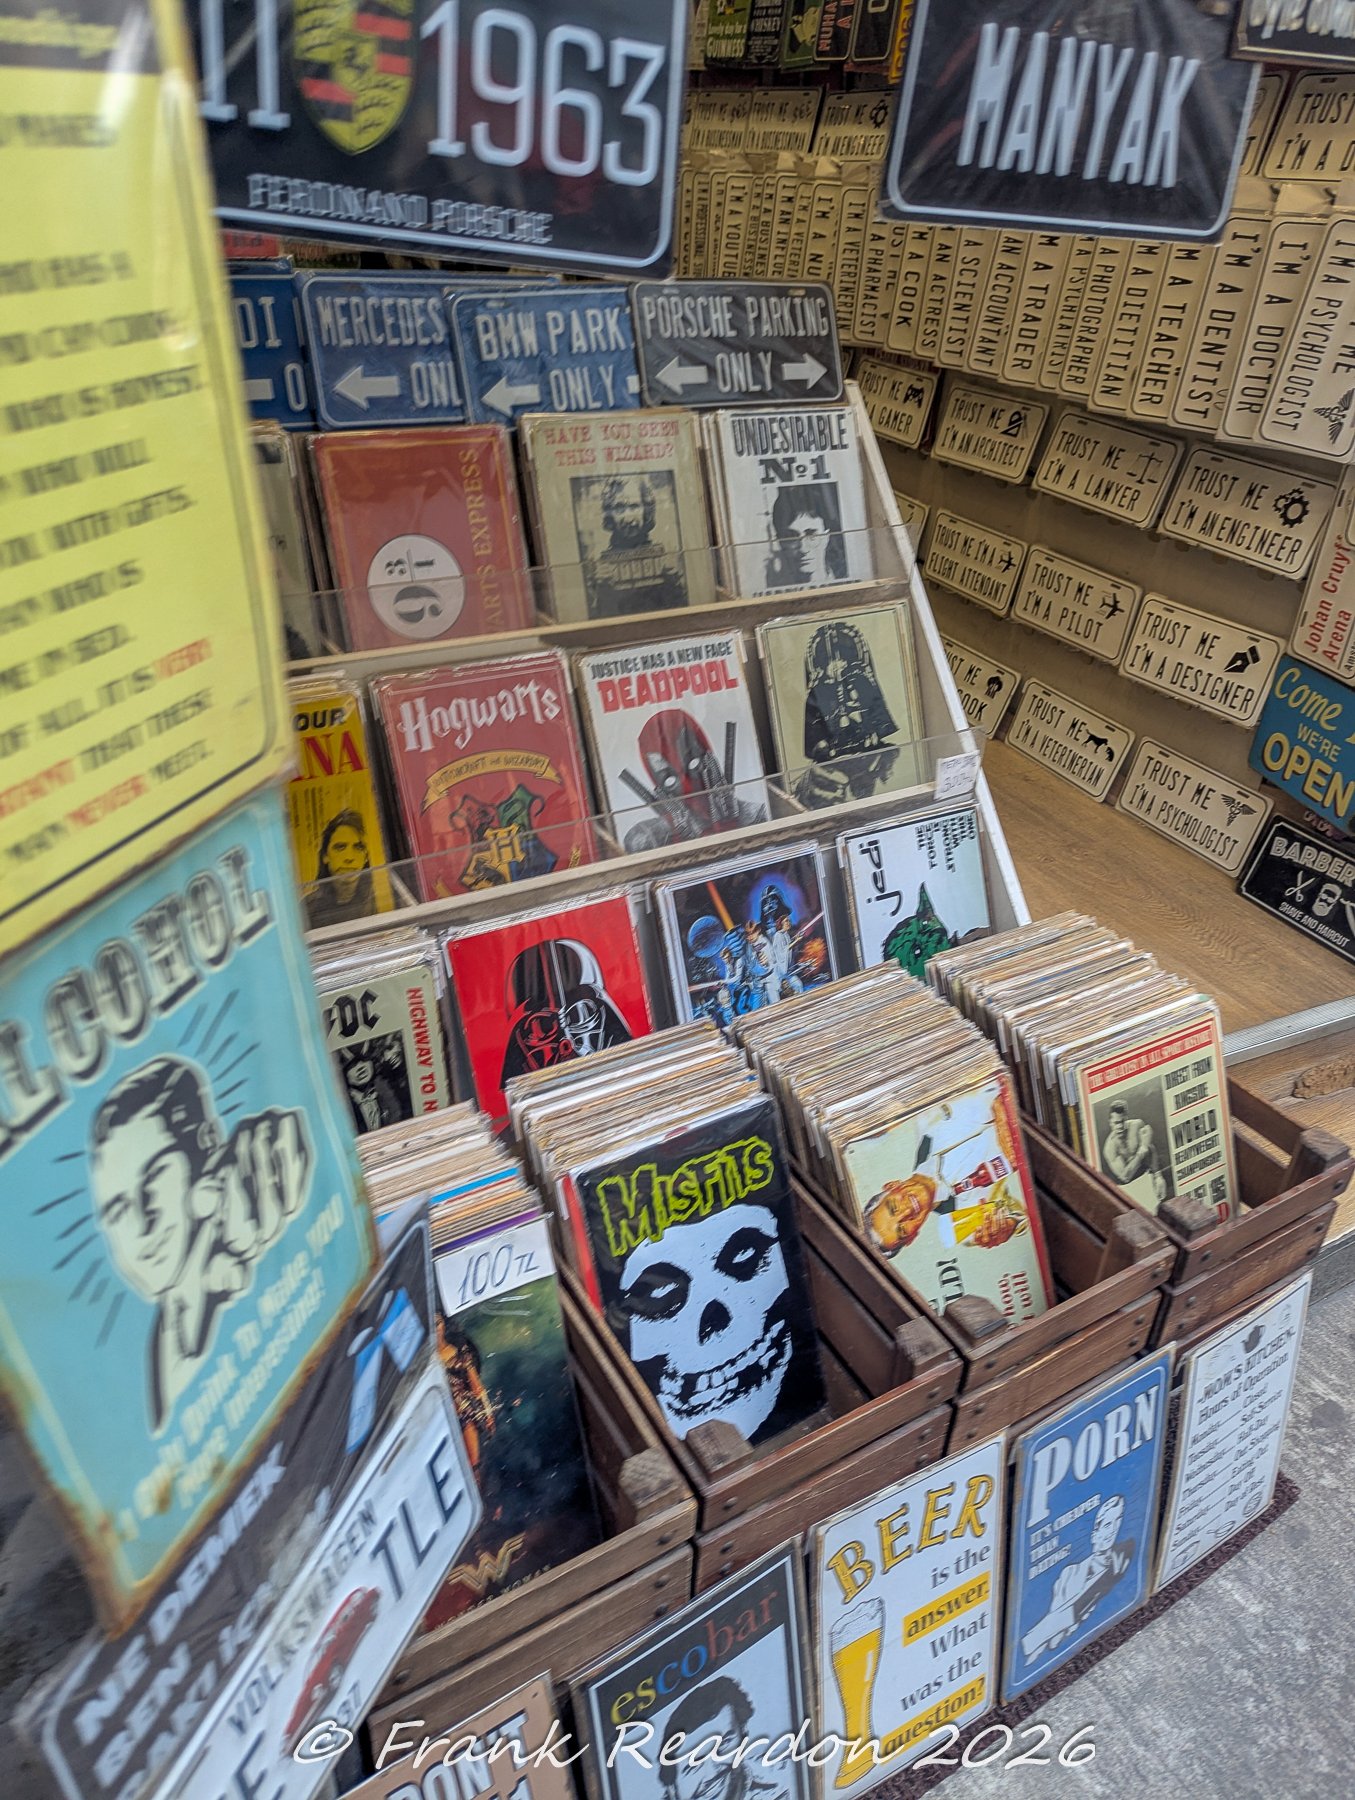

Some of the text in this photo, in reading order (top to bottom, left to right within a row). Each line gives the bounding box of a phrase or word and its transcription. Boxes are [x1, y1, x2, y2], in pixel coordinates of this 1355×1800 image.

[420, 0, 667, 187] 1963
[957, 23, 1200, 188] MANYAK
[1314, 139, 1334, 171] A
[315, 296, 449, 347] MERCEDES
[642, 295, 831, 340] PORSCHE PARKING
[859, 248, 885, 338] PHARMACIST
[895, 271, 921, 329] COOK
[921, 242, 954, 350] AN ACTRESS
[944, 255, 981, 358] SCIENTIST
[973, 235, 1025, 368] AN ACCOUNTANT
[1011, 260, 1054, 371] A TRADER
[475, 306, 636, 361] BMW PARK
[1064, 263, 1116, 386] PHOTOGRAPHER
[1100, 266, 1154, 397] A DIETITIAN
[1138, 275, 1194, 406] A TEACHER
[1184, 231, 1262, 420] I'M A DENTIST
[1235, 240, 1312, 414] I'M A DOCTOR
[1271, 273, 1351, 431] A PSYCHOLOGIST
[410, 361, 463, 409] ONL
[548, 364, 618, 412] ONLY
[714, 351, 775, 394] ONLY
[860, 370, 905, 400] TRUST ME
[543, 419, 681, 446] HAVE YOU SEEN
[731, 412, 850, 458] UNDESIRABLE
[877, 405, 914, 435] GAMER
[950, 397, 1008, 430] TRUST ME
[553, 442, 676, 468] THIS WIZARD?
[940, 424, 1026, 469] I'M AN ARCHITECT
[1056, 430, 1126, 471] TRUST ME
[458, 447, 494, 558] EXPRESS
[1042, 457, 1143, 513] I'M A LAWYER
[1186, 465, 1270, 512] TRUST ME
[935, 523, 962, 551] TRUST
[962, 534, 977, 558] ME
[988, 548, 998, 567] A
[1171, 497, 1200, 531] I'M
[1213, 513, 1304, 566] ENGINEER
[928, 551, 1008, 605] FLIGHT ATTENDANT
[1030, 562, 1095, 607] TRUST ME
[1303, 534, 1352, 654] Johan Cruyf
[1021, 589, 1104, 644] I'M A PILOT
[1141, 611, 1222, 661] TRUST ME
[1322, 609, 1353, 663] Arena
[596, 659, 740, 714] DEADPOOL
[963, 664, 983, 687] ME
[1128, 642, 1256, 715] I'M A DESIGNER
[1274, 667, 1344, 731] Come
[293, 707, 346, 732] OUR
[397, 679, 562, 752] Hogwarts
[1026, 694, 1087, 743] TRUST ME
[1296, 723, 1343, 763] WE'RE
[1015, 718, 1106, 788] I'M A VETERINERIAN
[1141, 755, 1218, 811] TRUST ME
[1262, 732, 1355, 818] OPEN
[1128, 782, 1240, 862] I'M A PSYCHOLOGIST
[1278, 901, 1351, 949] SHAVE AND HAIRCUT
[0, 846, 277, 1140] LCOHOL
[457, 1244, 515, 1309] 100
[1026, 1384, 1161, 1530] PORN
[368, 1434, 466, 1603] TLE
[825, 1473, 996, 1606] BEER
[930, 1544, 993, 1592] is the
[226, 1497, 378, 1738] VOLKSWAGEN
[906, 1582, 990, 1640] answer.
[928, 1611, 990, 1660] What
[608, 1589, 779, 1726] escobar
[899, 1650, 984, 1714] was the
[74, 1633, 151, 1746] NE
[94, 1641, 192, 1788] BEN
[882, 1675, 987, 1761] question?
[384, 1707, 530, 1800] ON'T
